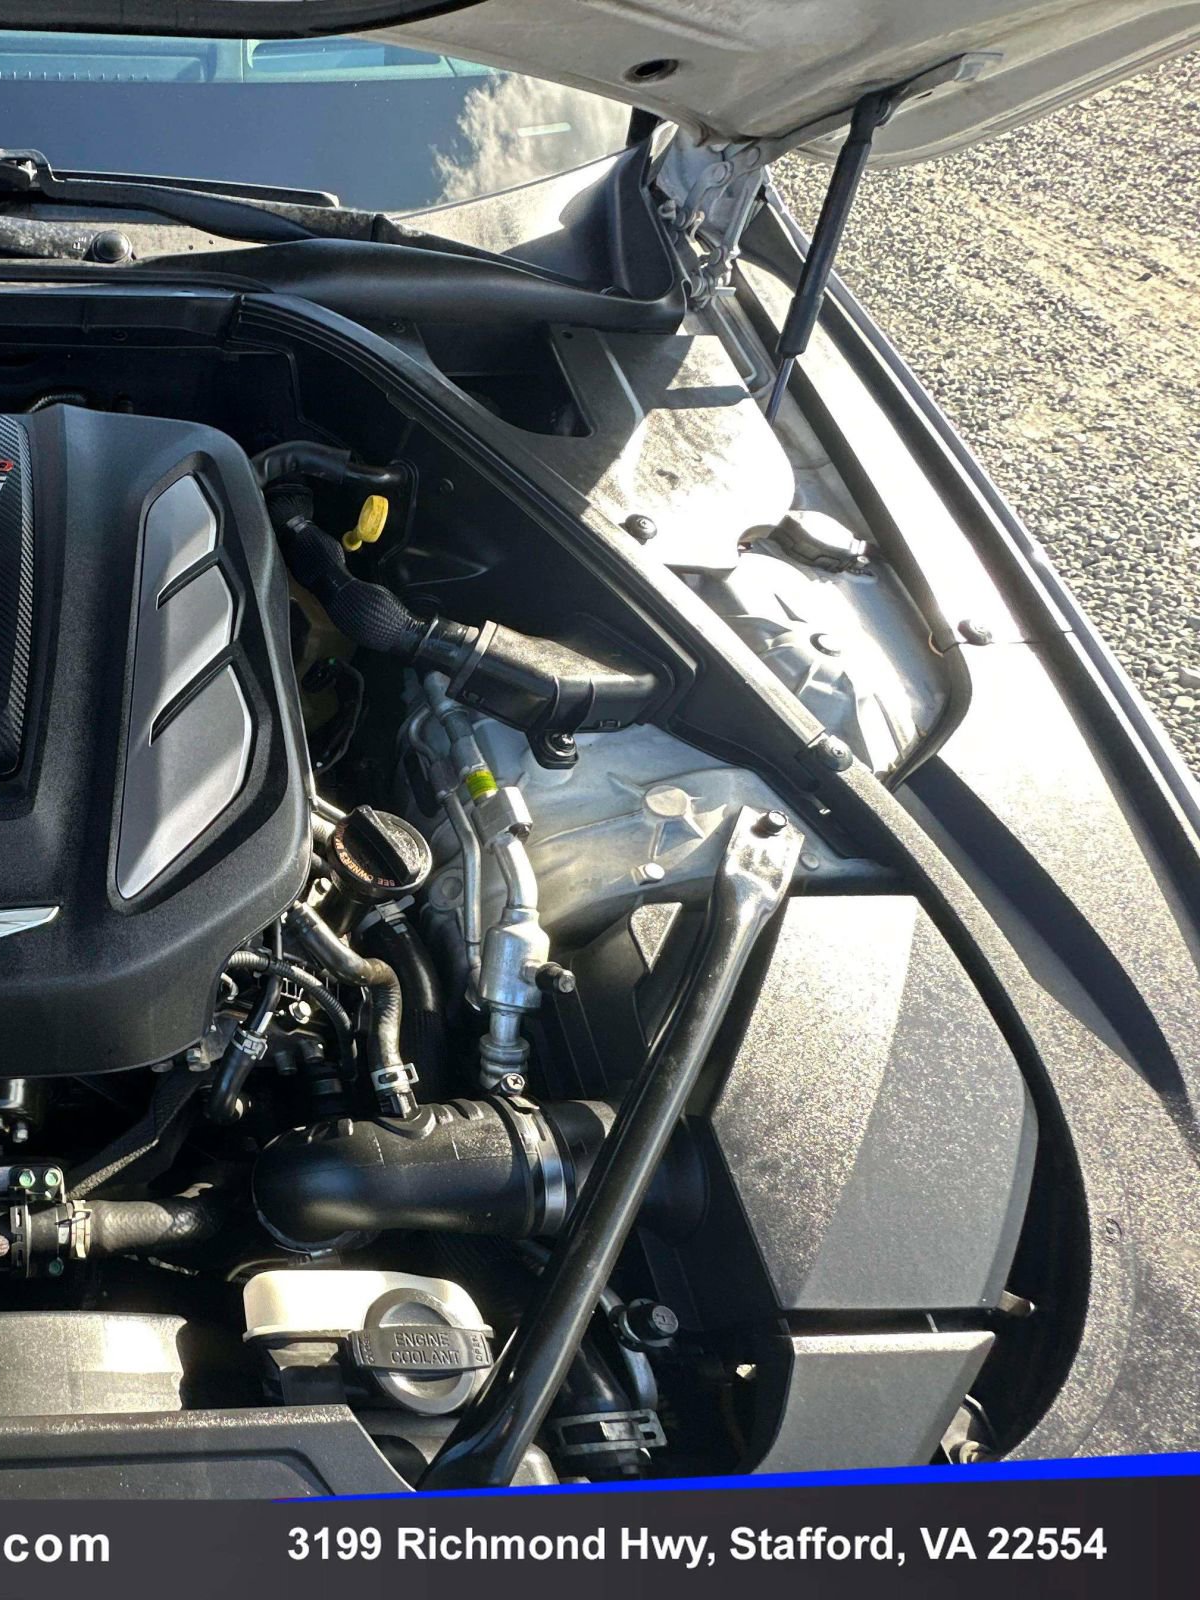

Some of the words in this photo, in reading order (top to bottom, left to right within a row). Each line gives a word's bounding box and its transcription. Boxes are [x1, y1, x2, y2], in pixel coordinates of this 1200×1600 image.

[377, 877, 396, 887] SEE
[394, 1332, 450, 1347] ENGINE
[471, 1334, 483, 1362] OPEN
[390, 1350, 460, 1365] COOLANT
